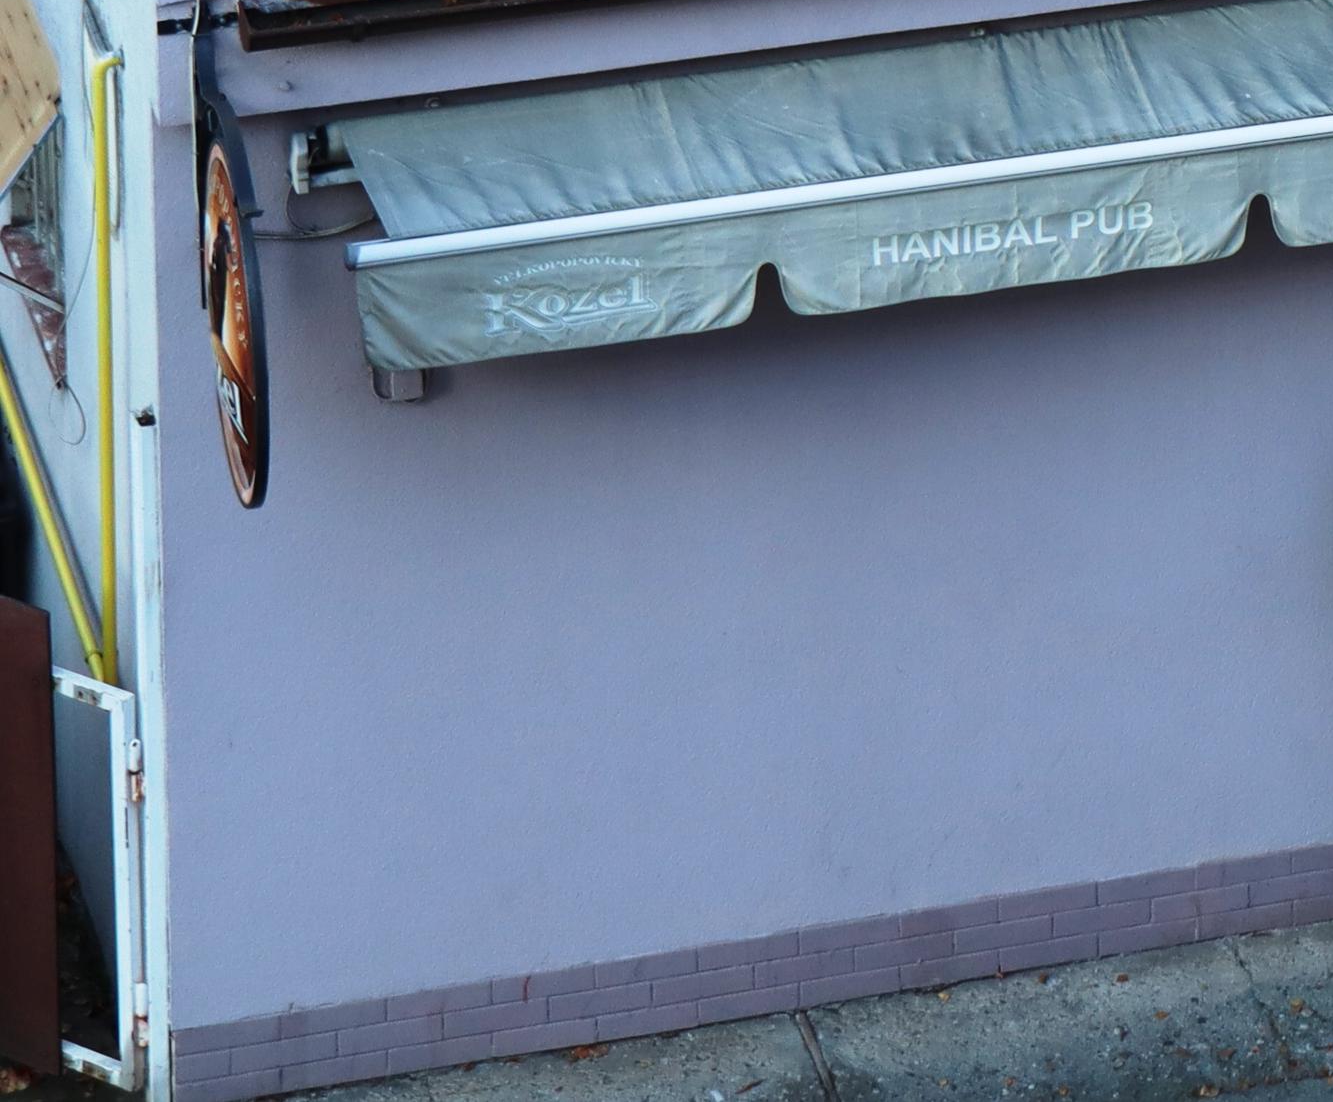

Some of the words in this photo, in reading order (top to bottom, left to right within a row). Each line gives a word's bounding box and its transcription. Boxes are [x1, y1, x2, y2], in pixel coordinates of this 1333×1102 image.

[872, 216, 1057, 267] HANIBAL
[1070, 201, 1155, 240] PUB
[483, 272, 658, 339] Kozel
